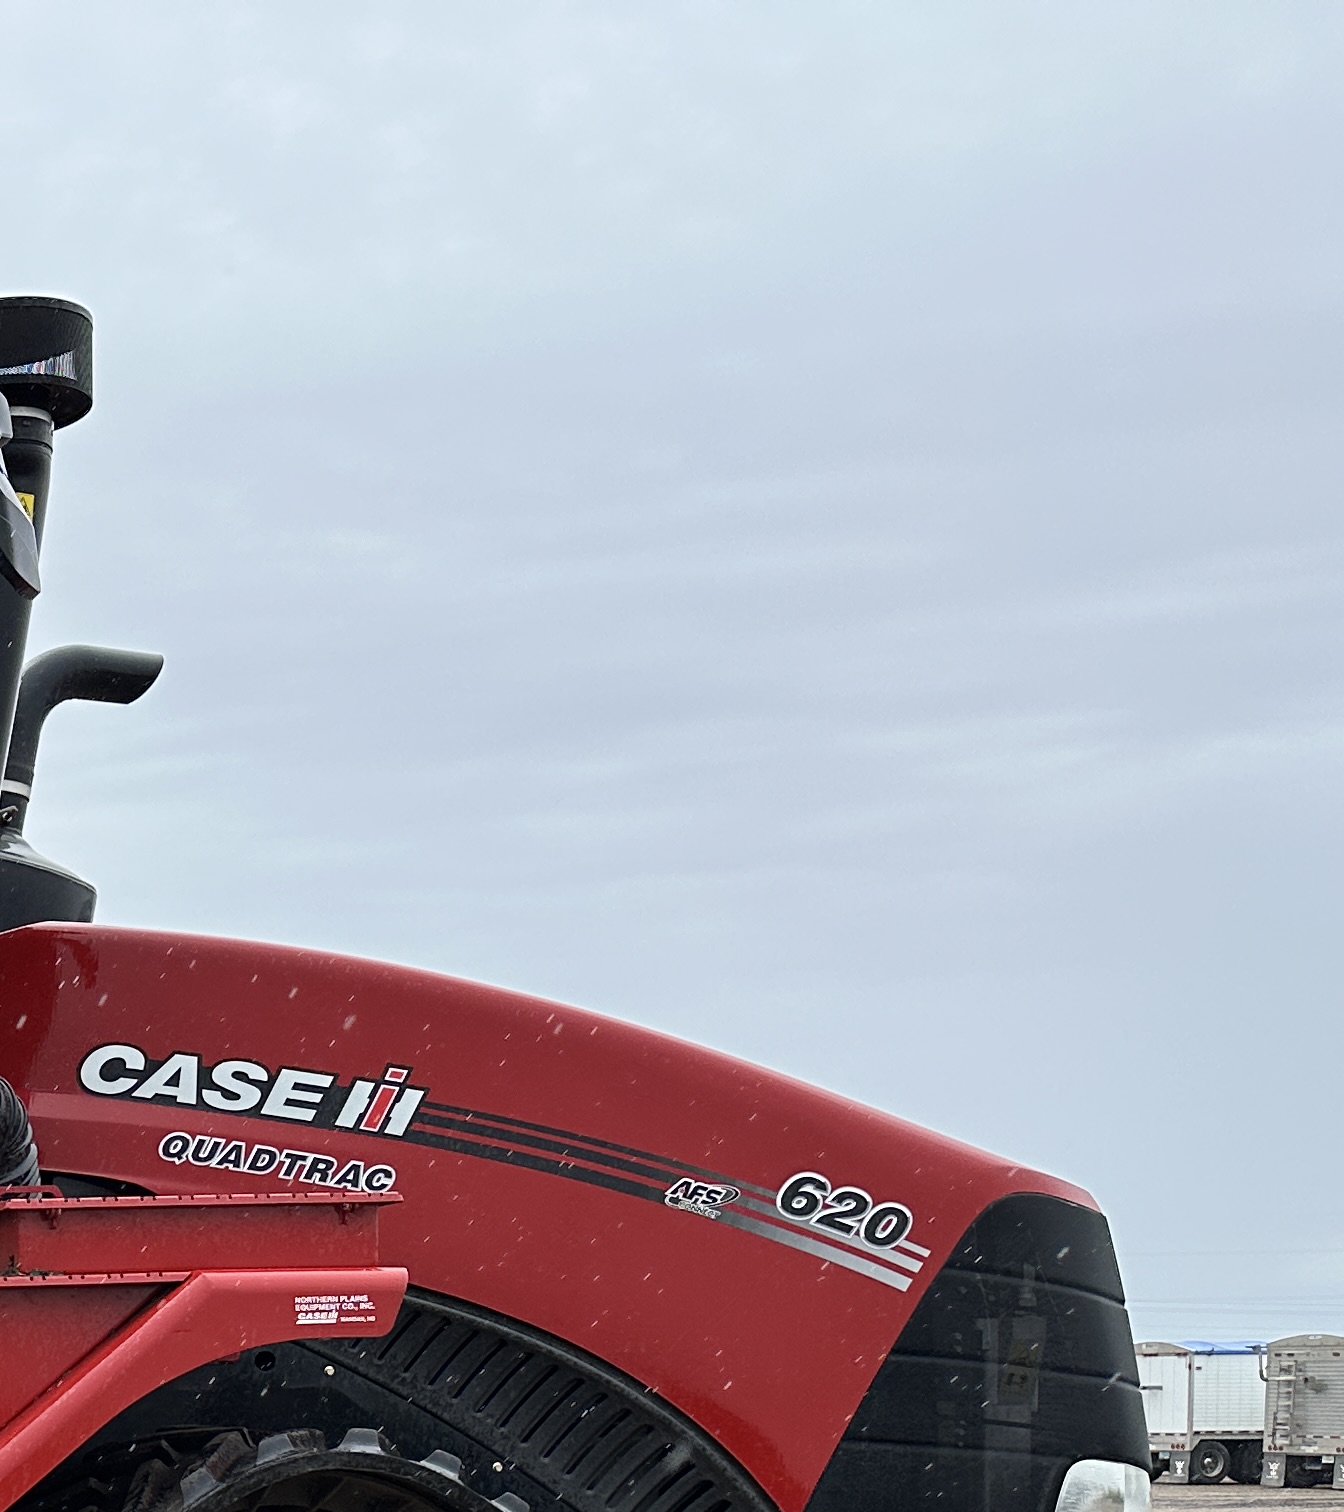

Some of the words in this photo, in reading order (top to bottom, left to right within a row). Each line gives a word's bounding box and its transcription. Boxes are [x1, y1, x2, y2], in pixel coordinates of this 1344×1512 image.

[79, 1043, 335, 1122] CASE
[158, 1131, 396, 1192] QUADTRAC
[665, 1178, 727, 1206] AFS
[776, 1171, 914, 1250] 620
[294, 1296, 339, 1304] NORTHERN
[339, 1295, 369, 1303] PLAINS
[294, 1303, 341, 1311] EQUIPMENT
[297, 1312, 328, 1320] CASE
